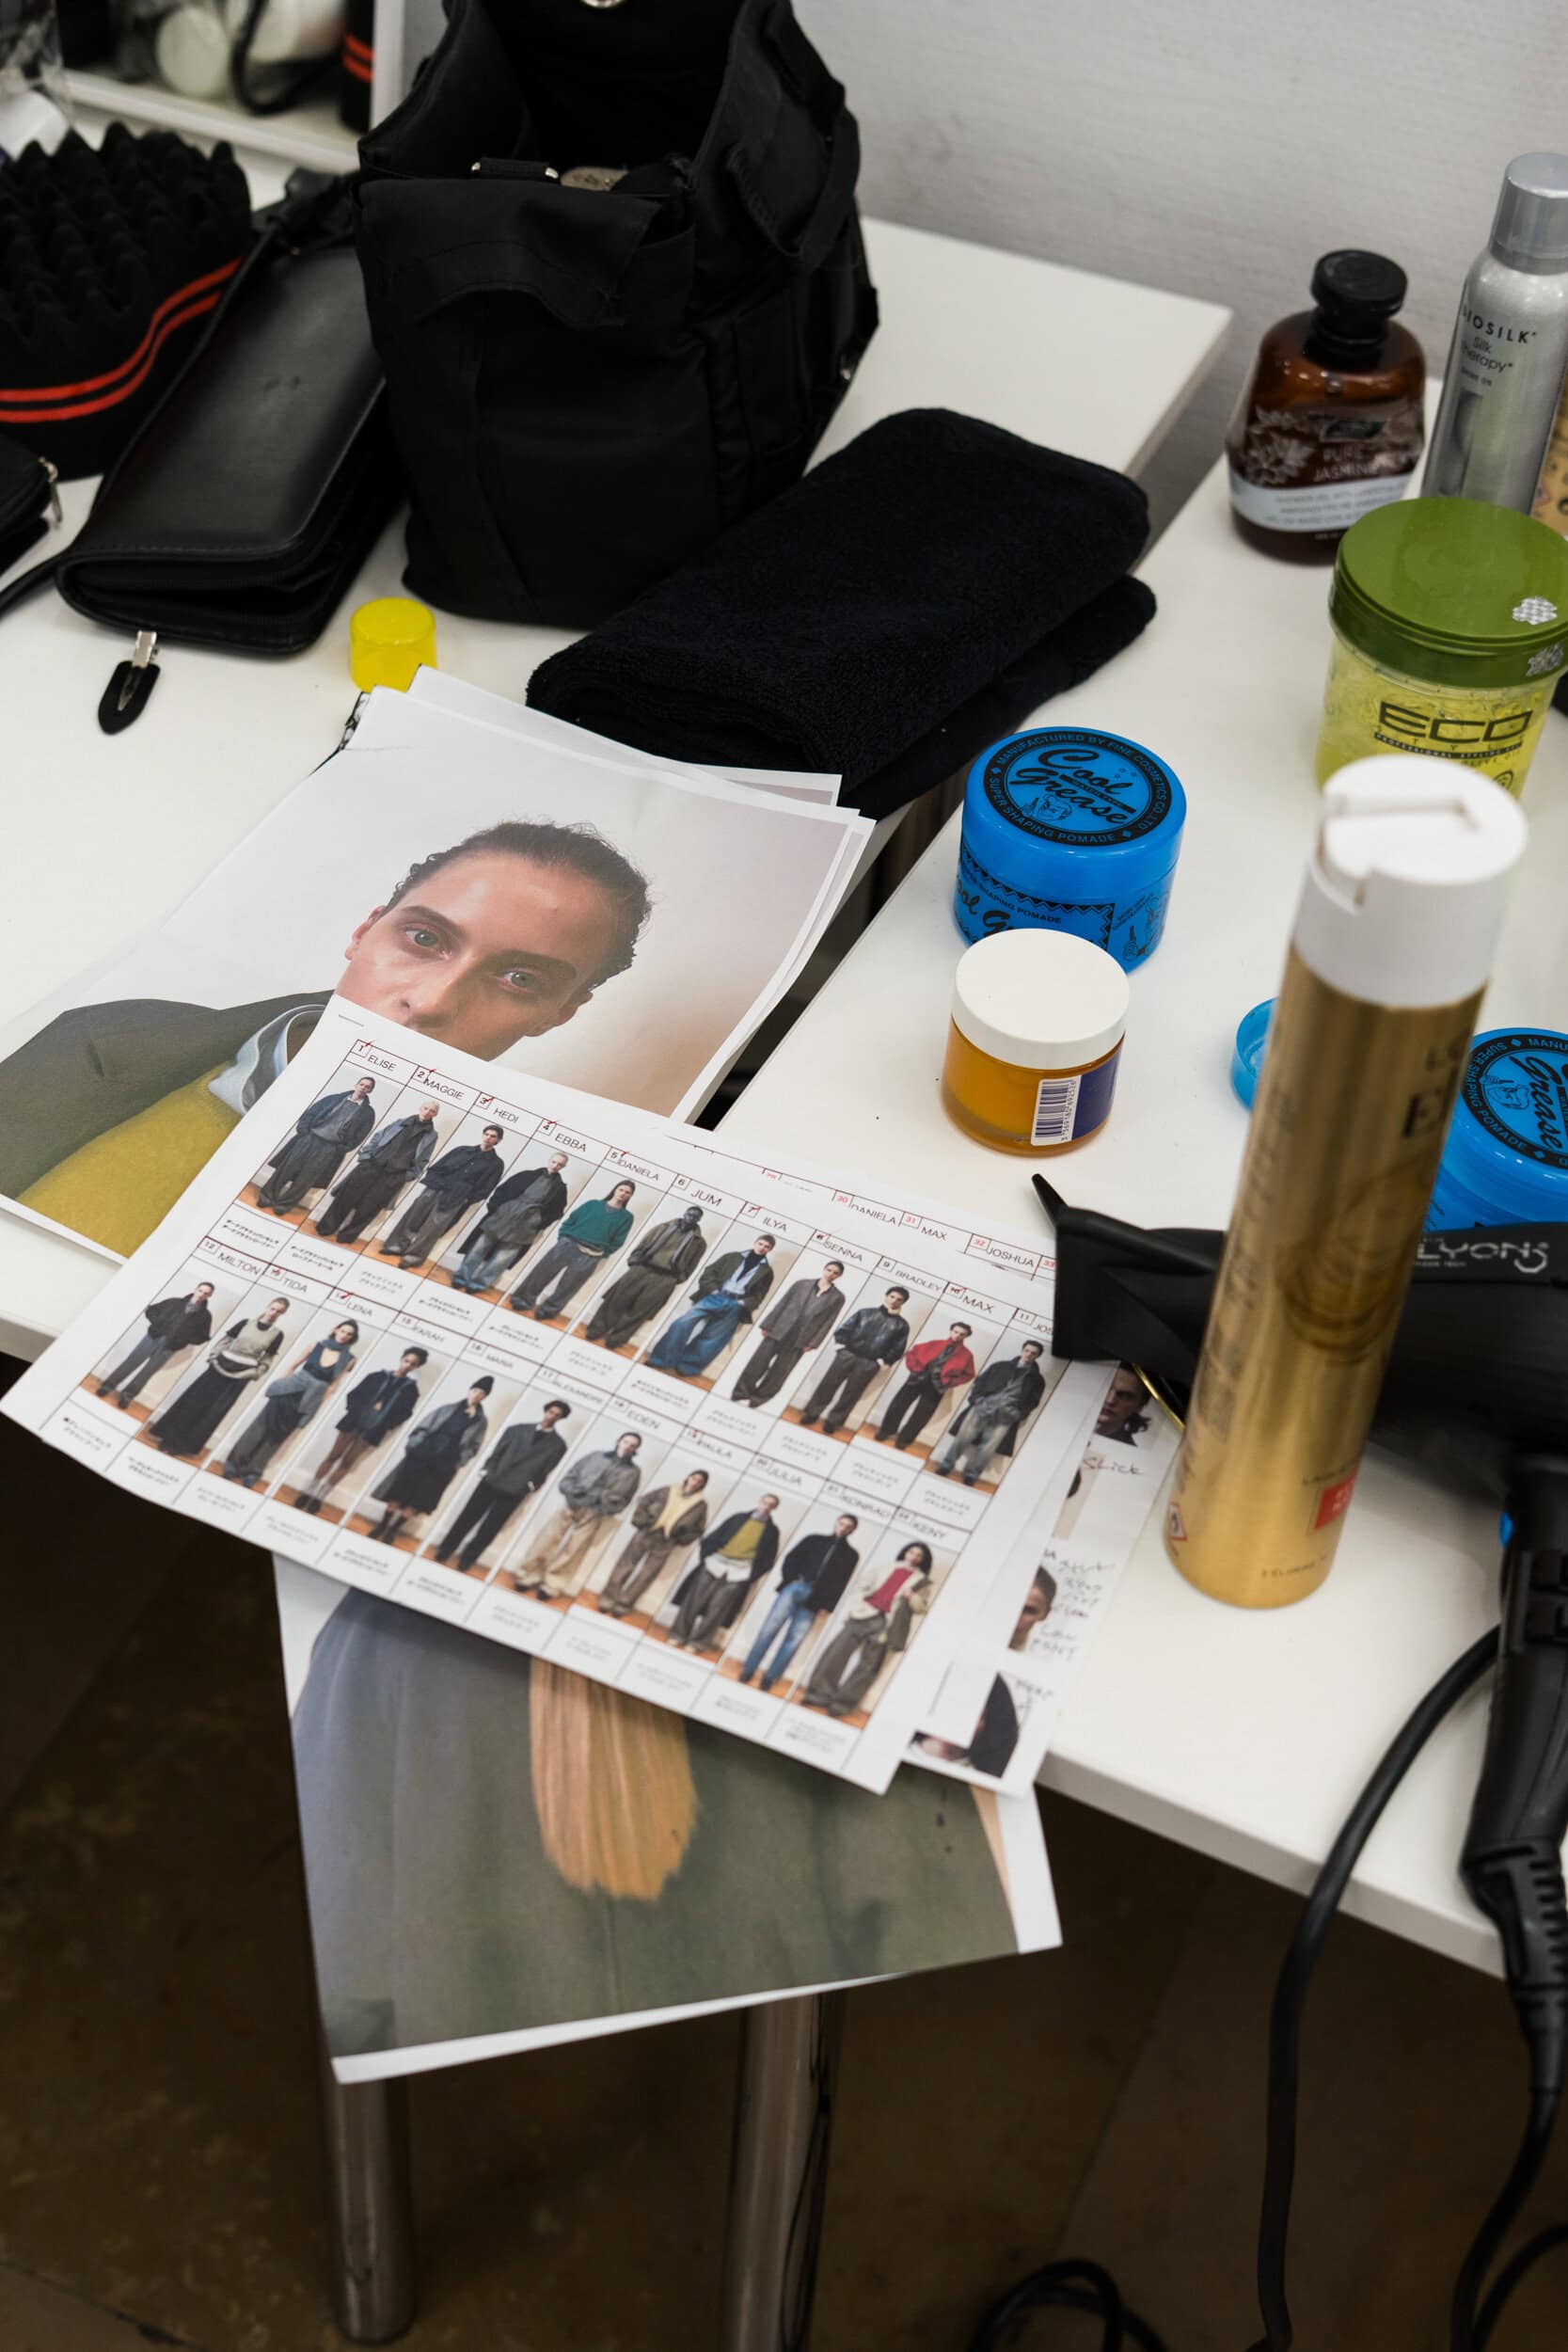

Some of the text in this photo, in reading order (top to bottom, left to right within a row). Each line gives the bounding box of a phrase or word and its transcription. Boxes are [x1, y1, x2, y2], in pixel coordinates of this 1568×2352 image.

[1379, 701, 1533, 743] ECO
[996, 734, 1085, 765] MANUFACTURED
[1088, 737, 1106, 745] BY
[1133, 755, 1166, 801] COSMETICS
[1037, 748, 1132, 795] Cool
[1009, 767, 1129, 824] Grease
[989, 777, 1116, 844] SUPER SHAPING POMADE
[1017, 906, 1062, 923] POMADE
[358, 1044, 364, 1053] 1
[367, 1055, 398, 1072] ELISE
[423, 1077, 466, 1100] MAGGIE
[1465, 1041, 1528, 1149] SUPER SHAPING POMADE
[480, 1097, 487, 1105] 3
[1509, 1056, 1562, 1150] Grease
[493, 1107, 519, 1124] HEDI
[555, 1133, 588, 1152] EBBA
[618, 1159, 660, 1182] DANIELA
[677, 1178, 686, 1186] 6
[690, 1188, 723, 1207] JUM
[851, 1203, 896, 1225] DANIELA
[762, 1216, 787, 1232] ILYA
[921, 1226, 948, 1242] MAX
[974, 1238, 986, 1248] 32
[823, 1241, 863, 1263] SENNA
[986, 1248, 1034, 1268] JOSHUA
[216, 1251, 262, 1276] MILTON
[283, 1278, 309, 1295] TIDA
[895, 1270, 942, 1292] BRADLEY
[962, 1295, 995, 1314] MAX
[1019, 1312, 1030, 1321] 11
